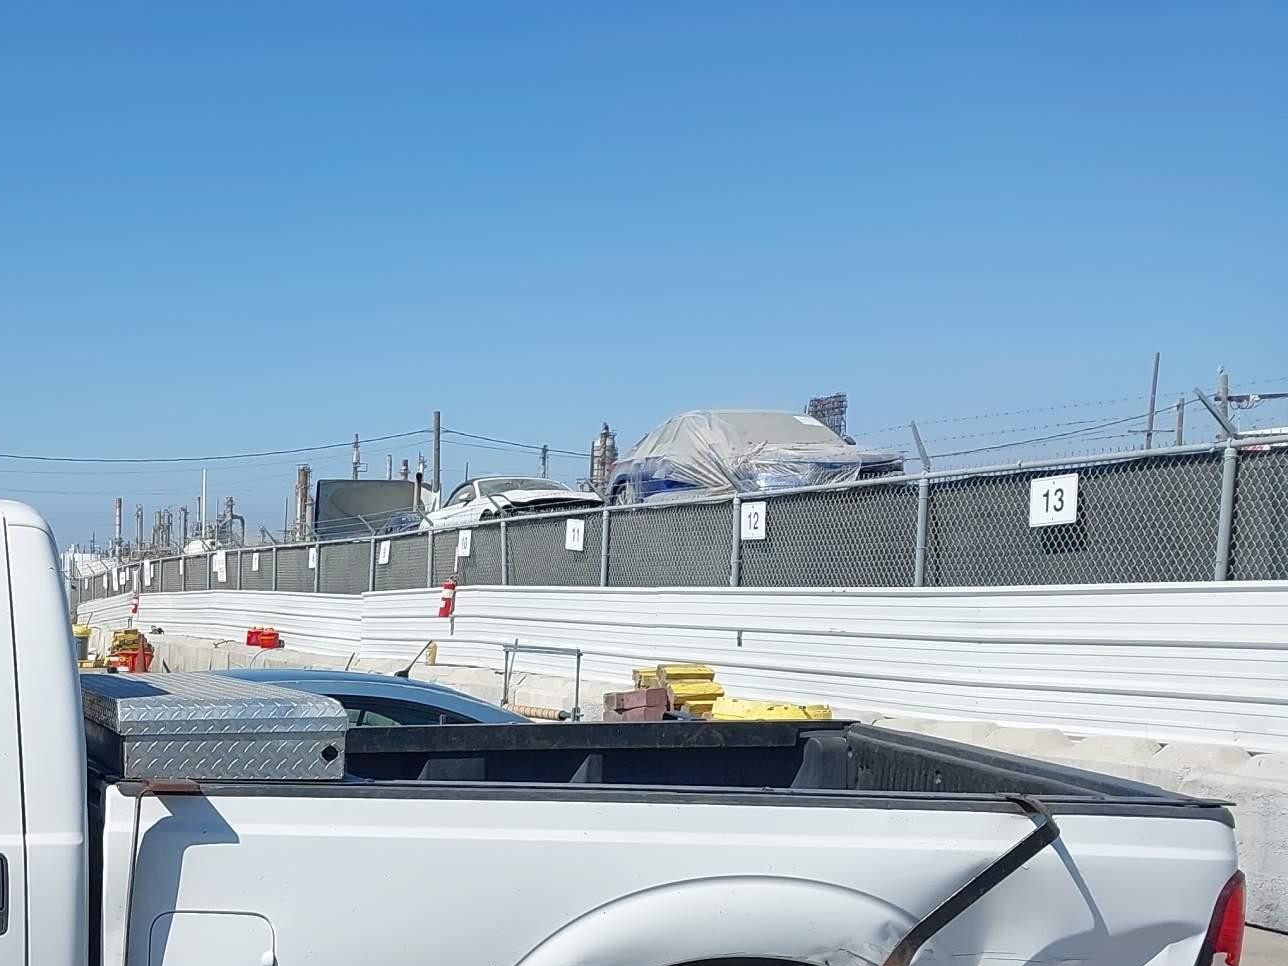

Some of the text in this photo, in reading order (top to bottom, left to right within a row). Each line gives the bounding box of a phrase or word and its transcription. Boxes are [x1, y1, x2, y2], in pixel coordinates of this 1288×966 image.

[1042, 487, 1065, 513] 13
[747, 511, 760, 531] 12
[571, 526, 581, 544] 11
